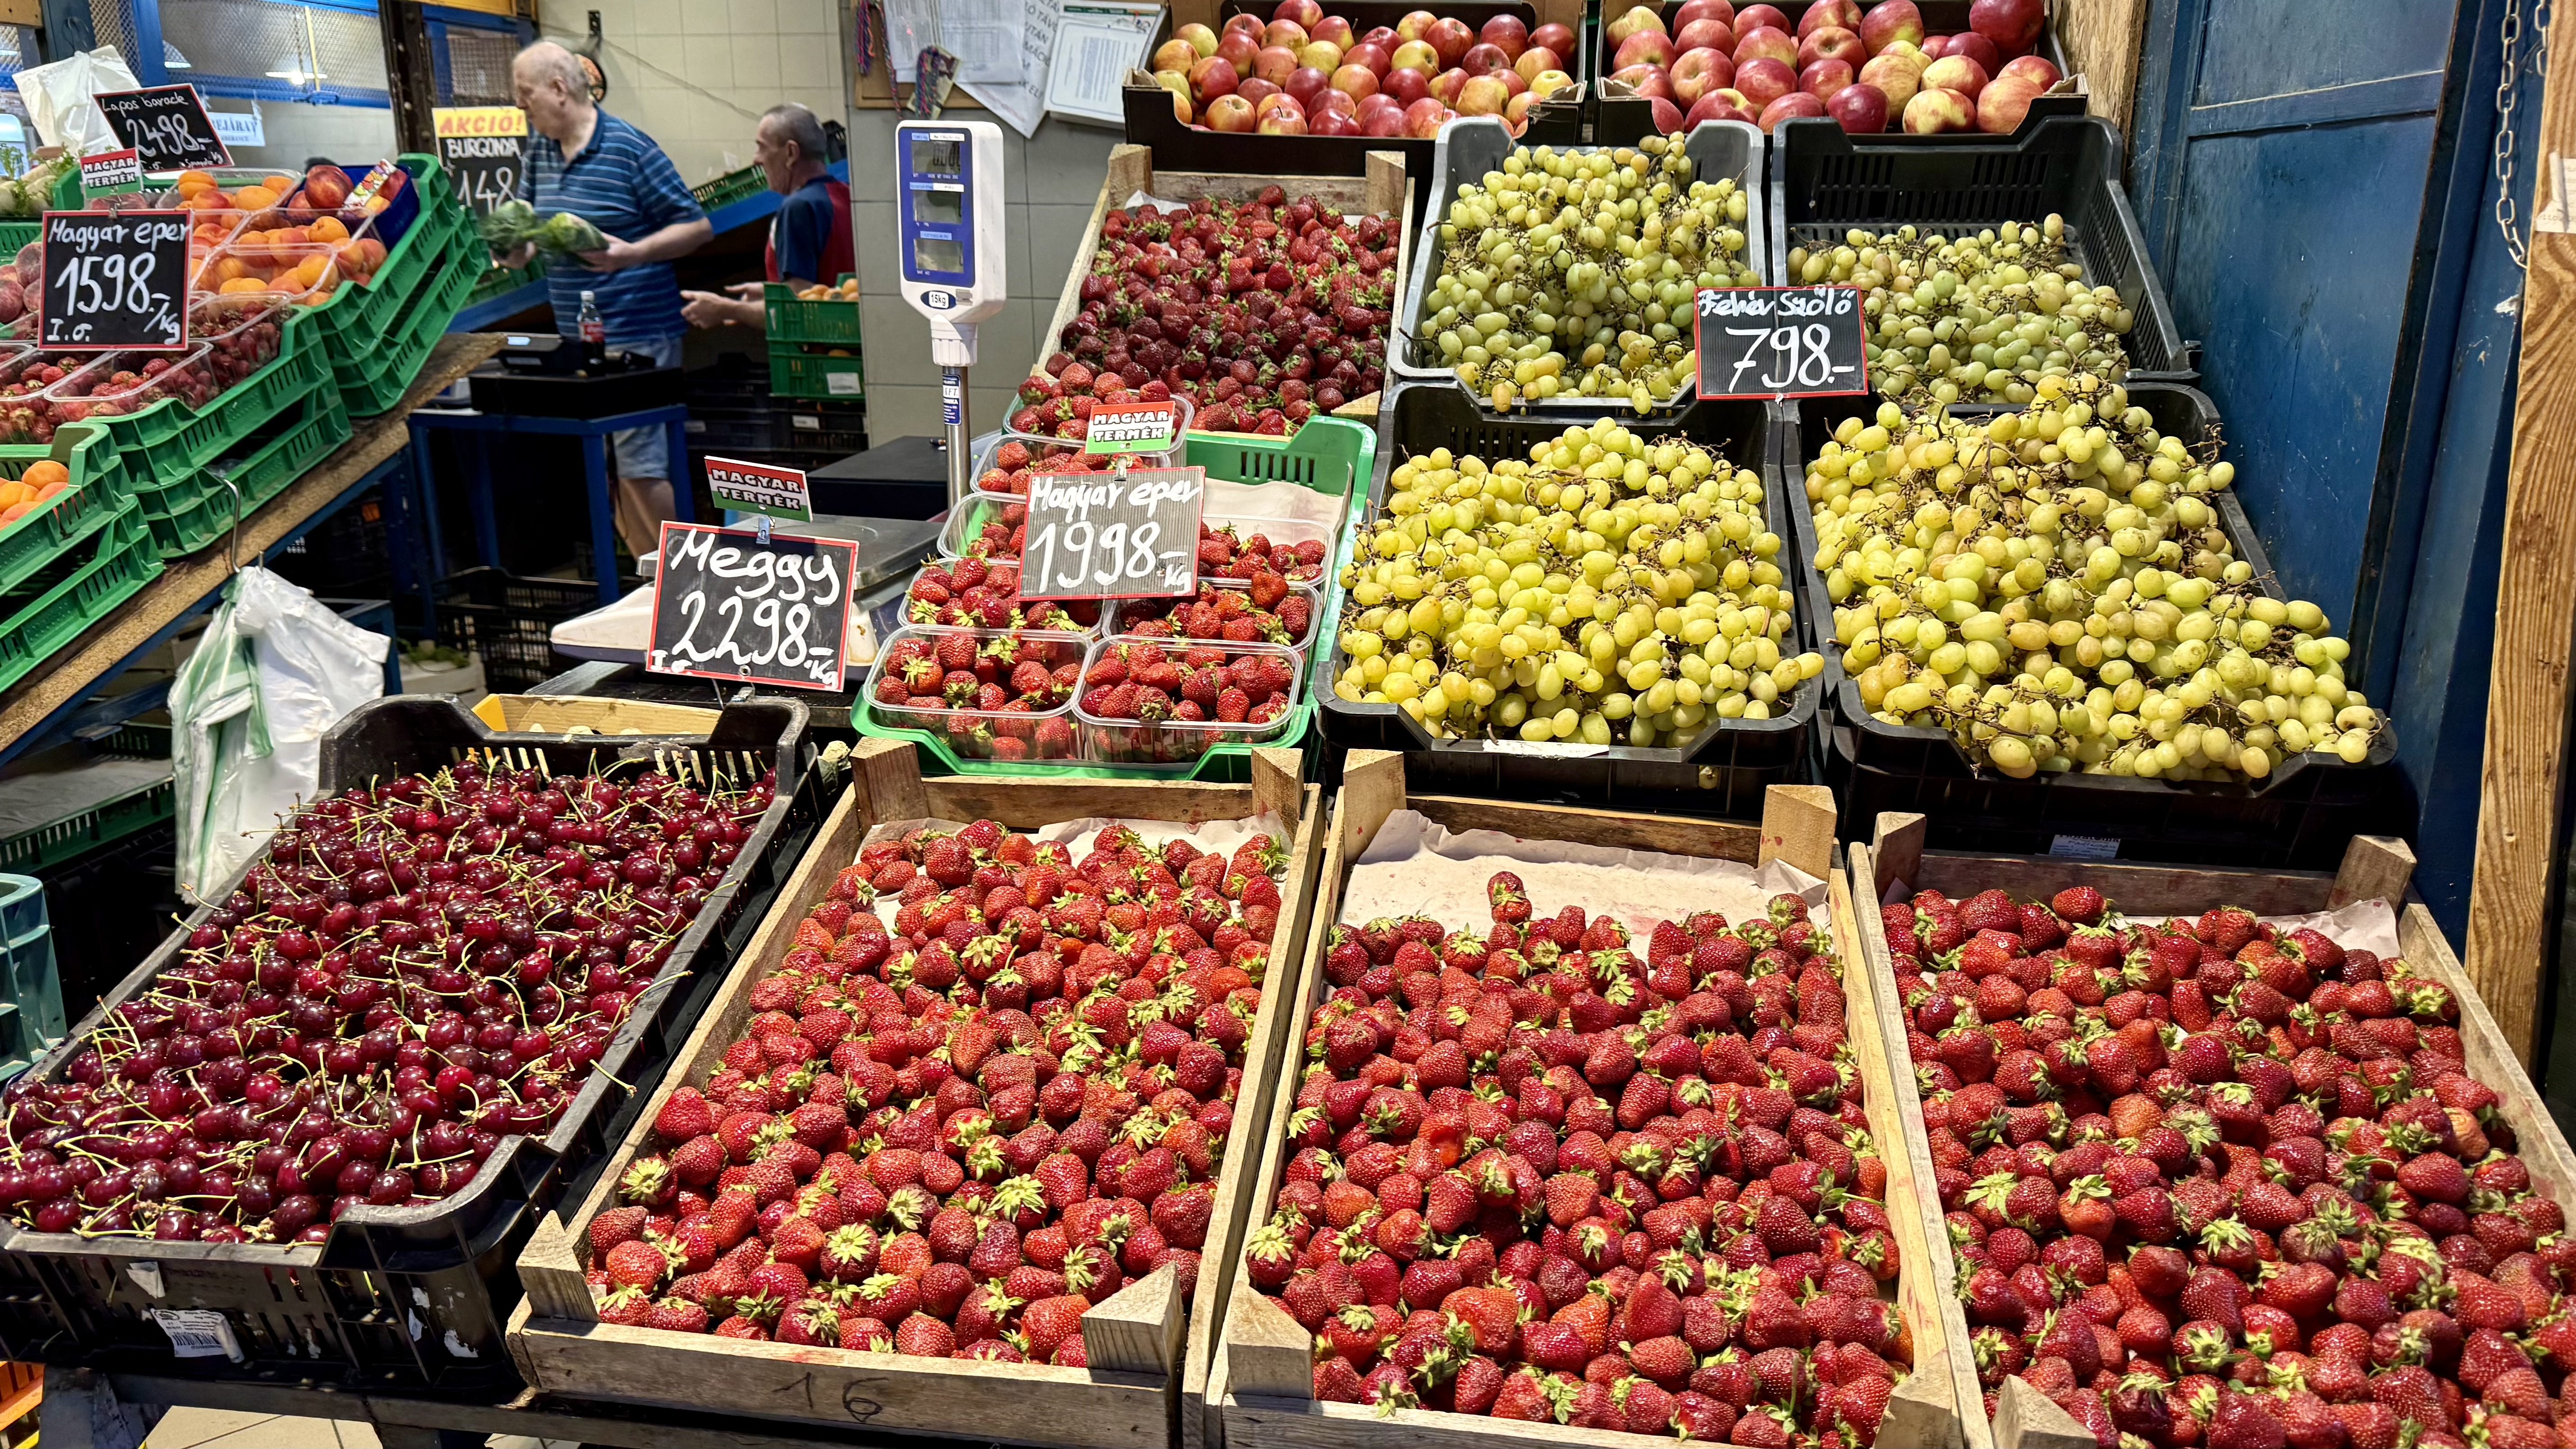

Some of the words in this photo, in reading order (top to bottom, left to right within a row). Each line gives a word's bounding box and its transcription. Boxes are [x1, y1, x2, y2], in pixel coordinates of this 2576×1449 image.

[101, 98, 139, 118] Lapos
[142, 92, 189, 108] barack
[439, 110, 522, 133] AKCIÓ!
[83, 156, 135, 174] MAGYAR
[87, 171, 136, 189] TERMÉK
[48, 218, 129, 253] Magyar
[134, 222, 191, 251] eper
[931, 294, 946, 306] 15kg
[1698, 290, 1775, 317] Fehér
[1093, 410, 1169, 425] MAGYAR
[1094, 426, 1164, 442] TERMÉK
[711, 468, 801, 493] MAGYAR
[718, 487, 801, 511] TERMÉK
[1029, 476, 1124, 523] Magyar
[1129, 480, 1200, 518] eper
[671, 528, 840, 605] Meggy
